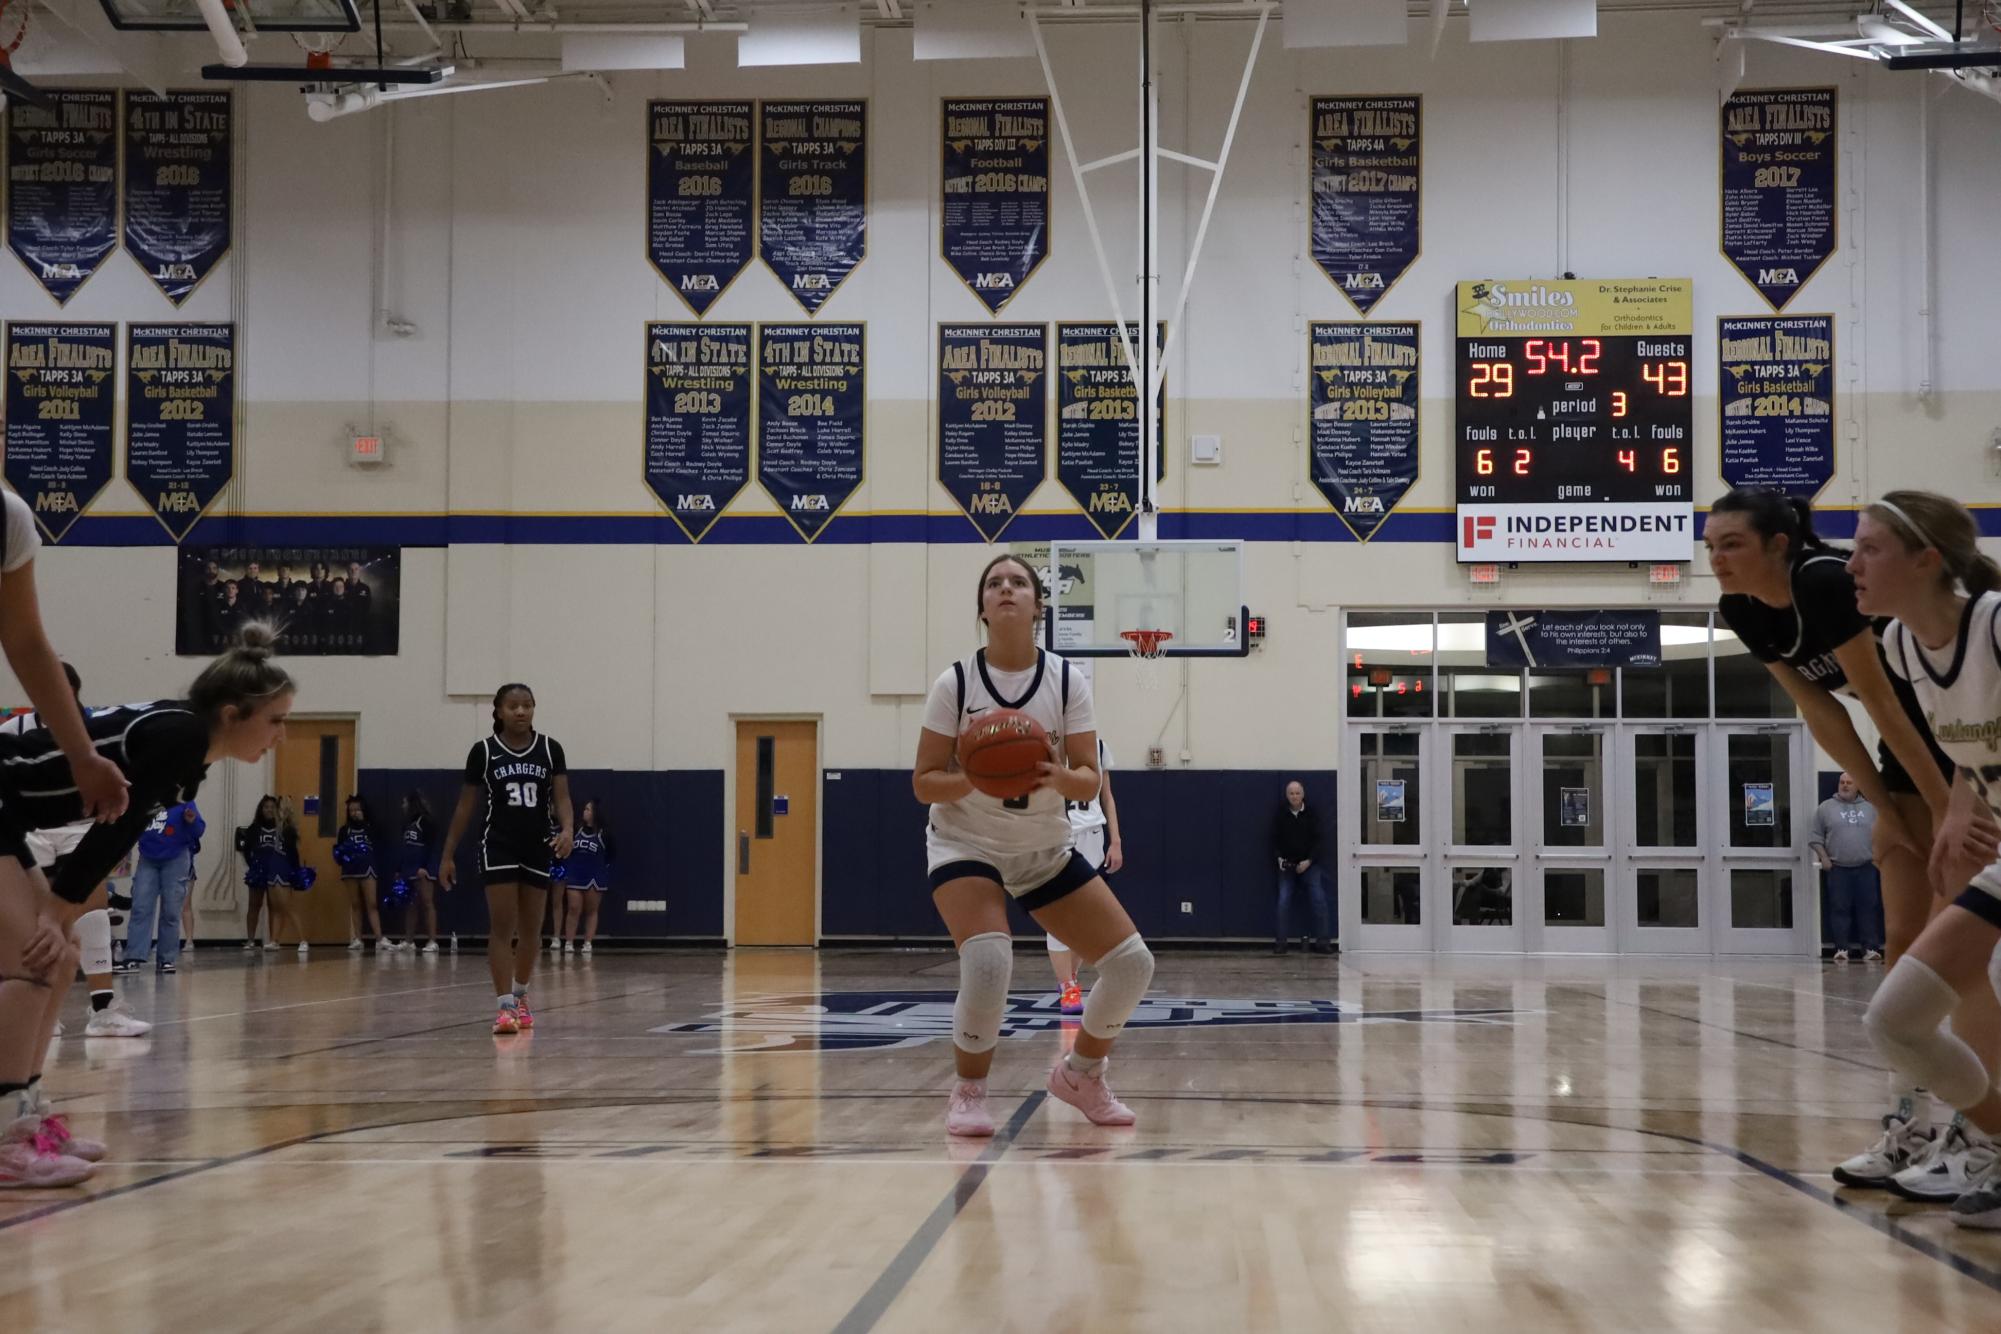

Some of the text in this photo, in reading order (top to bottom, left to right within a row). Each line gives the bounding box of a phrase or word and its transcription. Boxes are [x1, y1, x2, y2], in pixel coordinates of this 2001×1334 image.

[62, 94, 112, 102] CHRISTIAN
[178, 94, 227, 103] CHRISTIAN
[1778, 93, 1830, 102] CHRISTIAN
[654, 105, 749, 113] McKINNEY CHRISTIAN
[813, 104, 861, 112] CHRISTIAN
[948, 102, 1044, 111] McKINNEY CHRISTIAN
[1317, 101, 1414, 110] McKINNEY CHRISTIAN
[41, 132, 70, 143] TAPPS
[1756, 133, 1778, 146] TAPPS
[1780, 133, 1794, 145] DIV
[680, 143, 722, 156] TAPPS 3A
[792, 142, 834, 154] TAPPS 3A
[1346, 139, 1384, 151] TAPPS 4A
[970, 158, 1022, 168] Football
[1315, 156, 1416, 168] Girls Basketball
[1738, 151, 1822, 164] Boys Soccer
[675, 160, 728, 170] Baseball
[779, 159, 847, 170] Girls Track
[975, 172, 1016, 193] 2016
[1754, 166, 1801, 188] 2017
[678, 176, 722, 196] 2016
[788, 175, 832, 196] 2016
[1490, 284, 1574, 306] Smiles
[1599, 284, 1682, 294] Dr. Stephanie Crise
[1613, 296, 1668, 304] & Associates
[12, 327, 110, 336] McKINNEY CHRISTIAN
[1316, 327, 1414, 336] McKINNEY CHRISTIAN
[1489, 320, 1574, 330] Orthodontics
[1601, 323, 1612, 332] for
[1614, 322, 1644, 330] Children
[1653, 322, 1676, 330] Adults
[1724, 320, 1826, 330] McKINNEY CHRISTIAN
[134, 328, 230, 336] McKINNEY CHRISTIAN
[652, 328, 747, 336] McKINNEY CHRISTIAN
[764, 328, 860, 336] McKINNEY CHRISTIAN
[945, 328, 1041, 336] McKINNEY CHRISTIAN
[1062, 328, 1107, 336] McKINNEY
[1469, 342, 1506, 358] Home
[1637, 341, 1685, 357] Guests
[1525, 340, 1600, 374] 54.2
[40, 370, 84, 383] TAPPS 3A
[160, 370, 204, 384] TAPPS 3A
[1090, 370, 1118, 383] TAPPS
[1344, 370, 1388, 383] TAPPS 3A
[1754, 364, 1800, 378] TAPPS 3A
[972, 372, 1016, 384] TAPPS 3A
[1470, 364, 1513, 398] 29
[1643, 362, 1687, 396] 43
[662, 378, 734, 392] Wrestling
[776, 378, 848, 392] Wrestling
[1738, 380, 1815, 394] Girls Basketball
[24, 385, 98, 400] Girls Volleyball
[144, 386, 218, 398] Girls Basketball
[956, 387, 1030, 402] Girls Volleyball
[1074, 387, 1096, 398] Girls
[1328, 386, 1402, 400] Girls Volleyball
[674, 391, 721, 414] 2013
[788, 394, 834, 416] 2014
[1552, 398, 1596, 416] period
[1612, 392, 1626, 416] 3
[1754, 395, 1802, 416] 2014
[38, 399, 80, 420] 2011
[160, 400, 204, 420] 2012
[970, 401, 1016, 421] 2012
[1090, 400, 1135, 420] 2013
[1466, 426, 1498, 440] fouls
[1552, 424, 1597, 442] player
[1652, 424, 1683, 440] fouls
[1477, 450, 1492, 474] 6
[1515, 450, 1530, 474] 2
[1618, 450, 1634, 472] 4
[1664, 448, 1679, 474] 6
[1470, 484, 1495, 497] won
[1558, 485, 1592, 499] game
[1655, 484, 1681, 496] won
[1507, 516, 1688, 532] INDEPENDENT
[1507, 538, 1616, 548] FINANCIAL
[1630, 624, 1646, 632] only
[1224, 628, 1235, 642] 2
[494, 763, 548, 780] CHARGERS
[506, 782, 538, 808] 30
